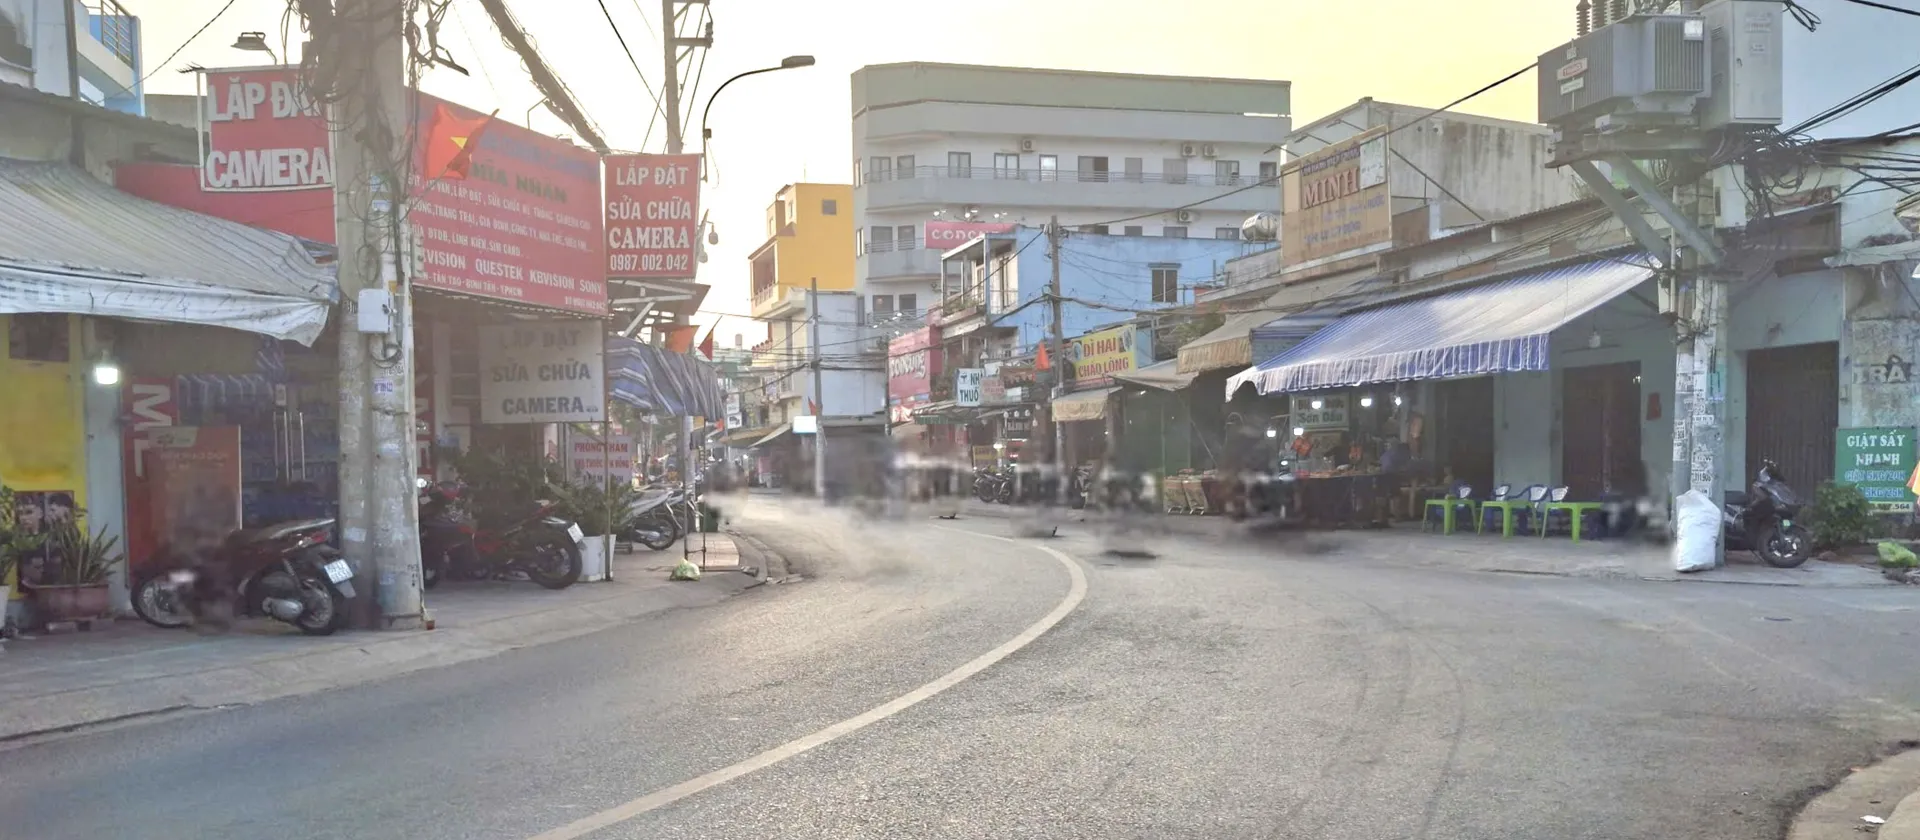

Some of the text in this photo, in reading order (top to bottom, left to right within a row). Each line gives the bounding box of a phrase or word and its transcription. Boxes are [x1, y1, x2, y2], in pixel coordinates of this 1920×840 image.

[206, 147, 332, 188] CAMERA
[616, 158, 649, 186] LẮP
[654, 162, 689, 189] ĐẶT
[1303, 165, 1360, 208] MINH
[608, 194, 692, 220] SỬA CHỮA
[608, 226, 690, 249] CAMERA
[609, 253, 688, 271] 0987.002.042
[475, 257, 524, 281] QUESTEK
[529, 269, 575, 290] KBVISION
[579, 279, 602, 294] SONY
[970, 371, 984, 386] NH
[502, 396, 584, 415] CAMERA
[1879, 429, 1905, 447] SẤY
[1856, 453, 1900, 466] NHANH
